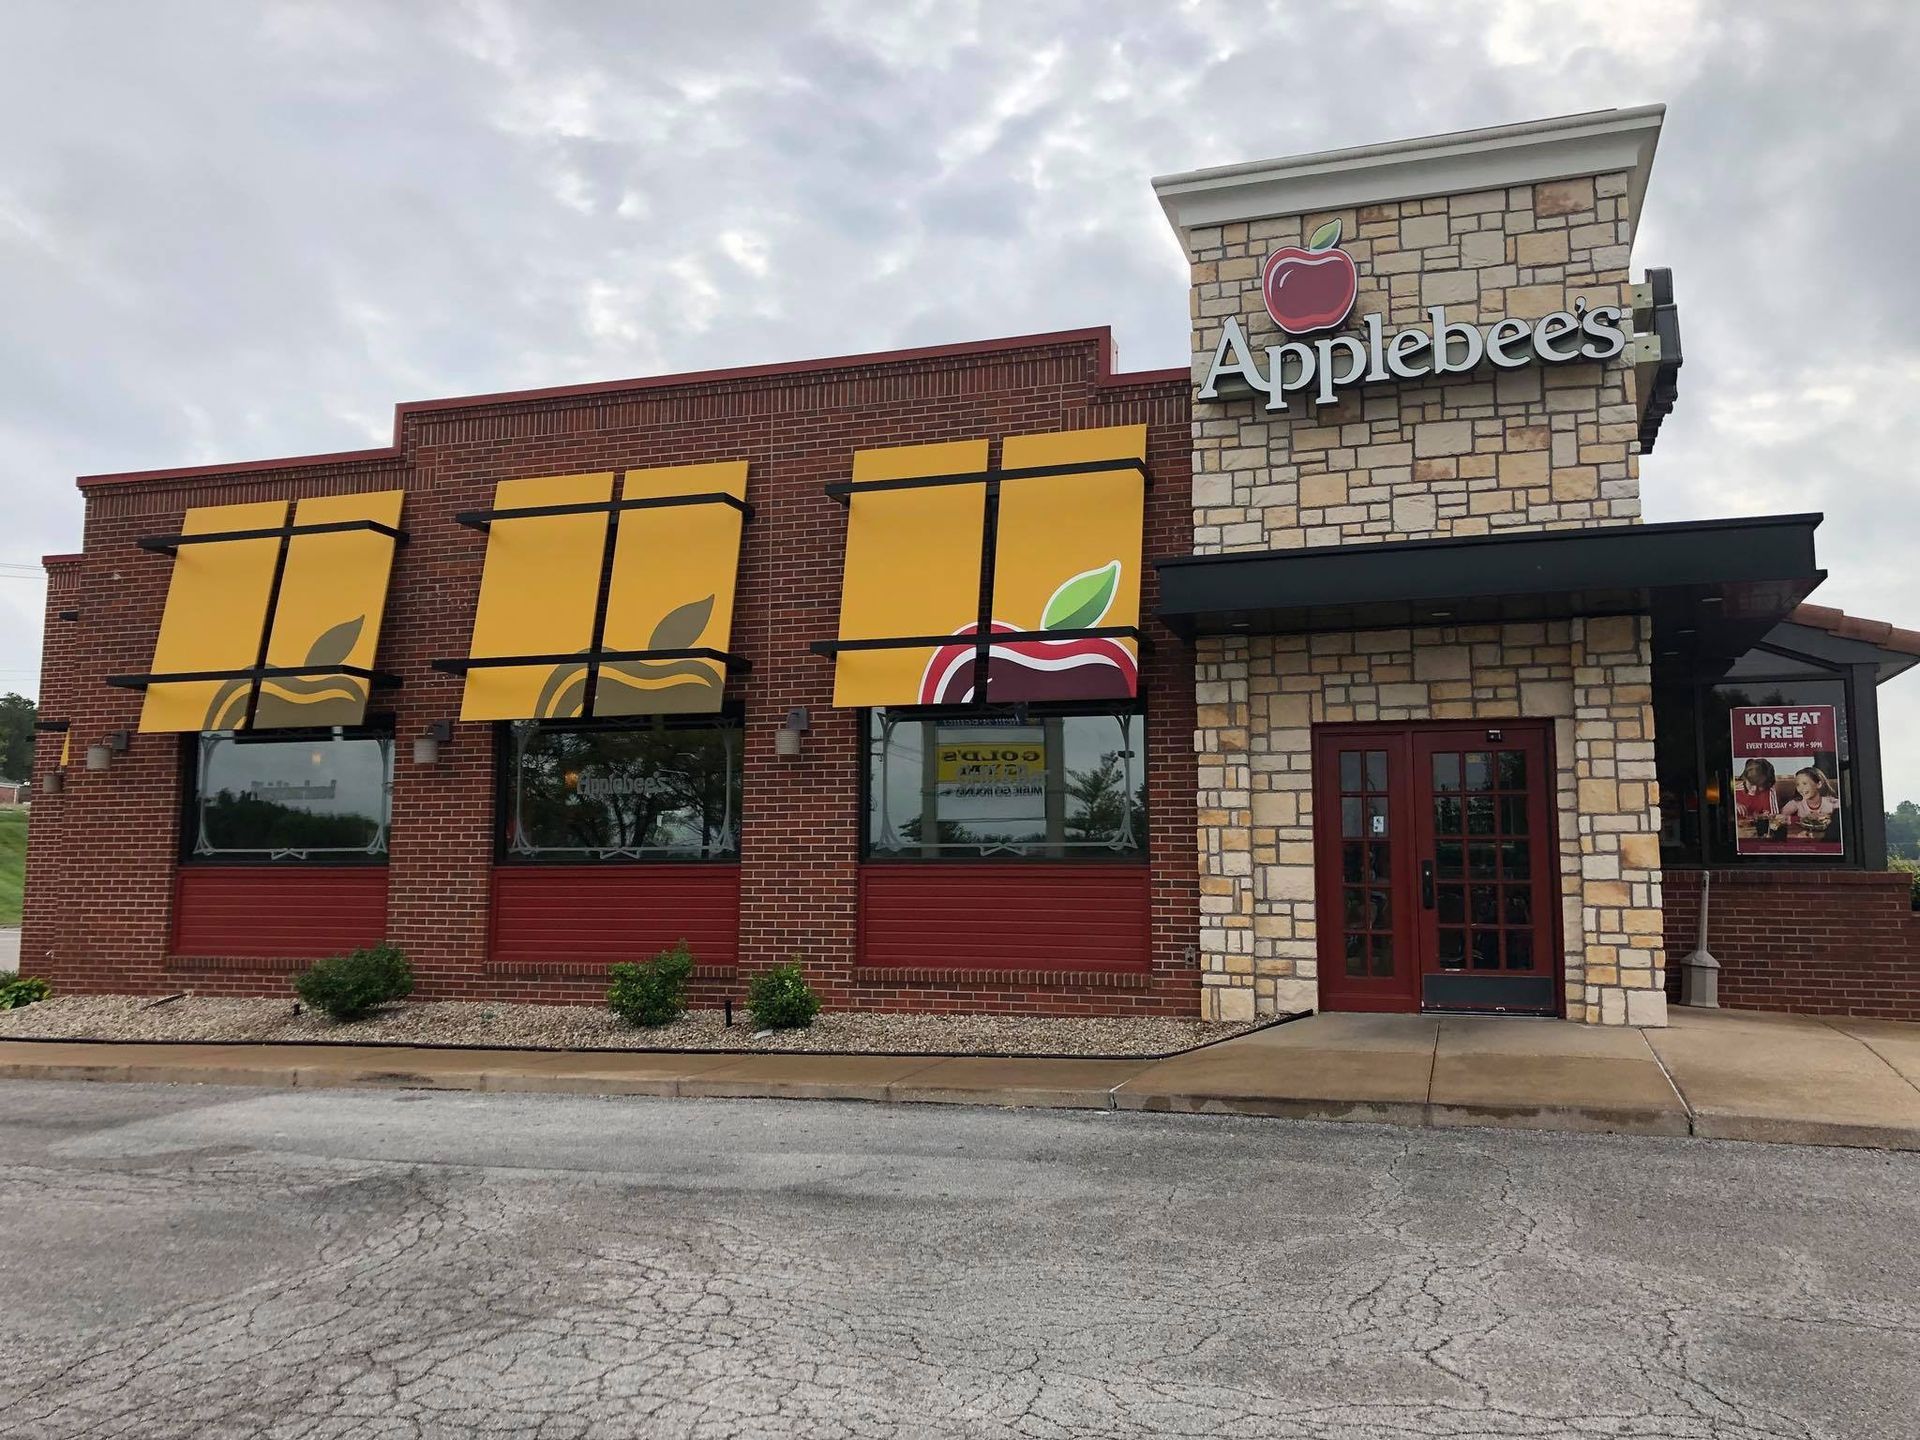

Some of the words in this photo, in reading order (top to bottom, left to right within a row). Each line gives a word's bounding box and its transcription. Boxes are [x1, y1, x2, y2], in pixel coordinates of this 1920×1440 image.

[1198, 296, 1627, 413] Applebee's
[1744, 713, 1784, 725] KIDS
[1788, 712, 1820, 724] EAT
